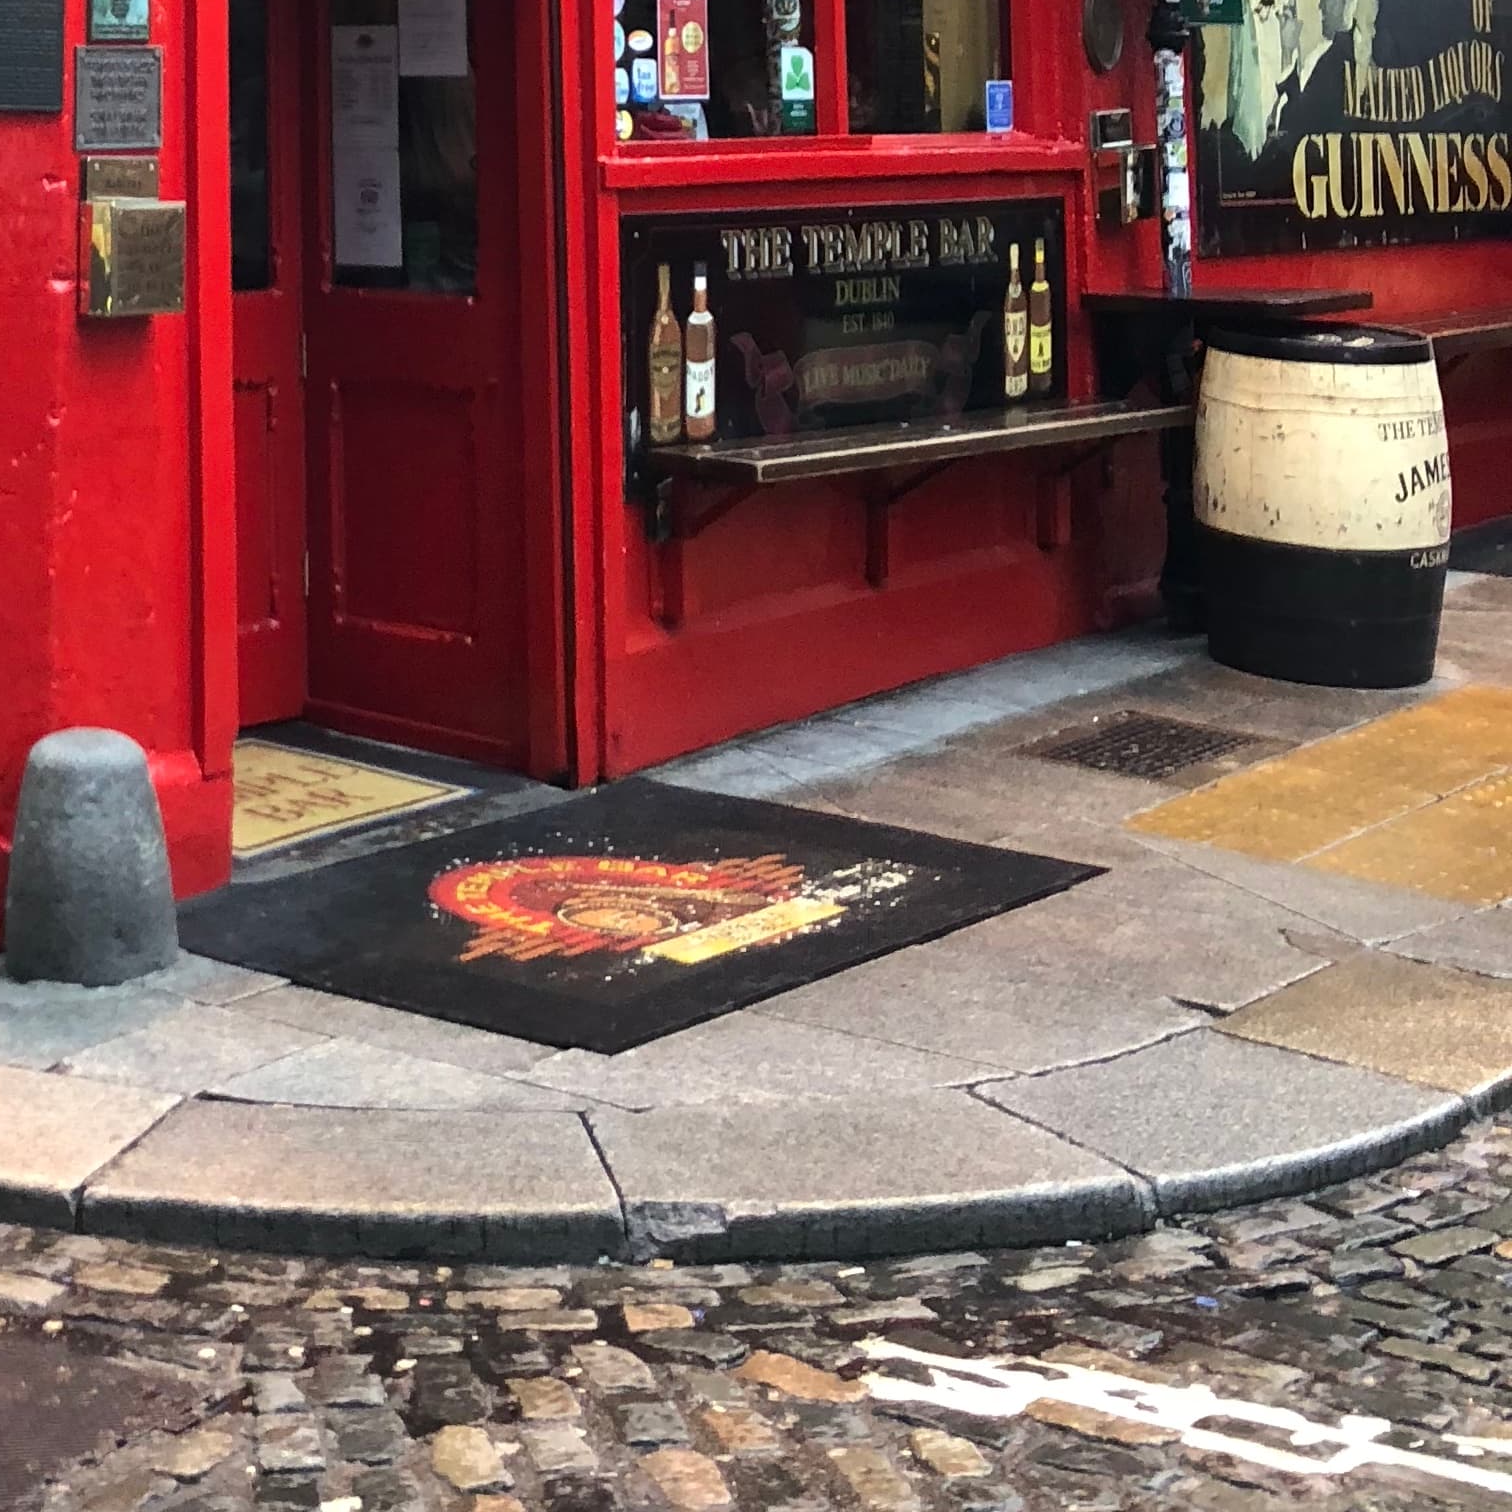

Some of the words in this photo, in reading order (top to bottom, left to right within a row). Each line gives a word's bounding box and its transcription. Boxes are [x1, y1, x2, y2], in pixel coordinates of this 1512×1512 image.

[1343, 59, 1426, 123] MALTED
[1428, 38, 1505, 113] LIQUORS
[1292, 131, 1512, 219] GUINNESS
[720, 227, 793, 280] THE
[801, 219, 930, 274] TEMPLE
[938, 216, 999, 265] BAR
[835, 275, 901, 306] DUBLIN
[888, 355, 931, 384] DAILY
[1378, 419, 1415, 442] THE
